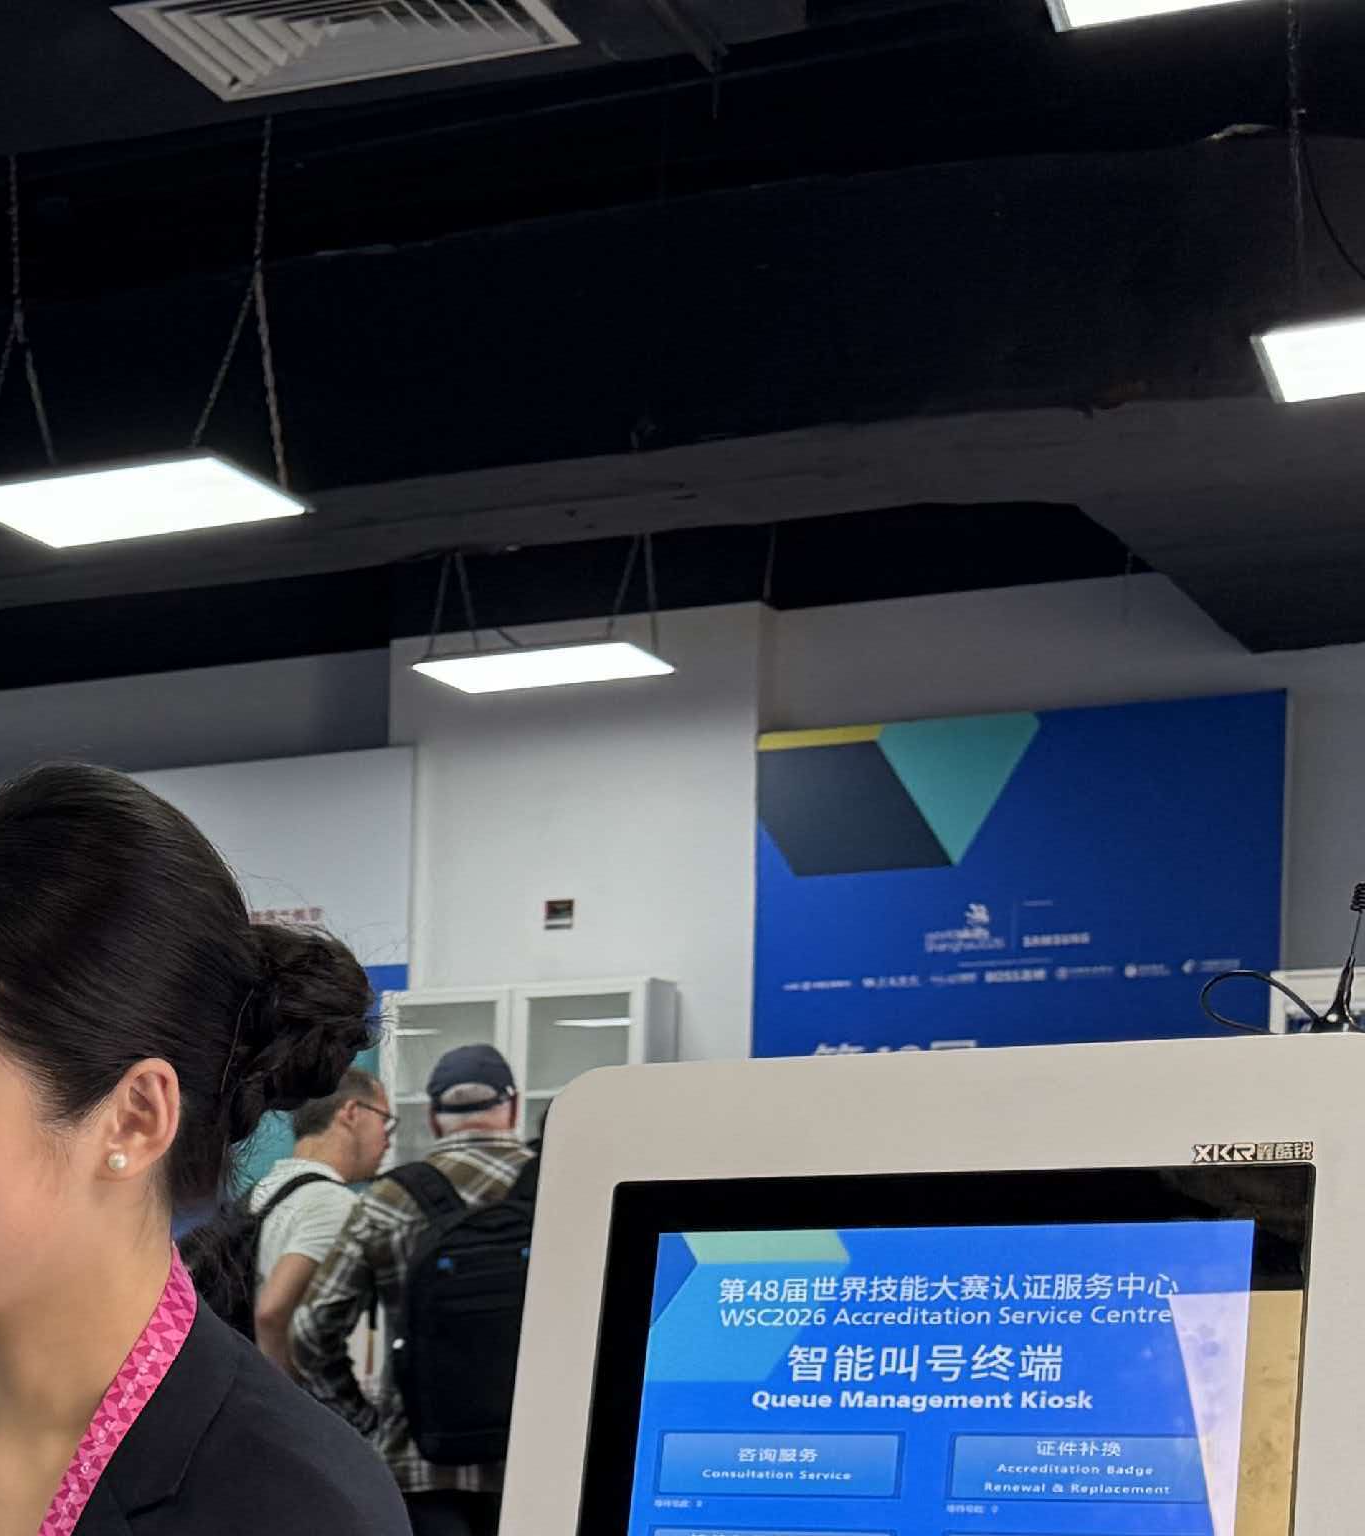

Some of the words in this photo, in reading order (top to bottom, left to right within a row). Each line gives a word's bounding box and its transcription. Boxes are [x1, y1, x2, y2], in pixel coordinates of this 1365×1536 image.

[719, 1271, 1179, 1305] 第48届世界技能大赛认证服务中心
[720, 1307, 826, 1328] WSC2026
[833, 1306, 991, 1327] Accreditation
[999, 1305, 1082, 1325] Service
[1091, 1305, 1172, 1324] Centre
[787, 1343, 1064, 1384] 智能叫号终端
[751, 1390, 832, 1410] Queue
[839, 1390, 1012, 1413] Management
[1020, 1390, 1093, 1410] Kiosk
[737, 1447, 818, 1463] 咨询服务
[1036, 1440, 1121, 1457] 证件补换
[701, 1468, 794, 1480] Consultation
[799, 1470, 852, 1481] Service
[996, 1463, 1100, 1475] Accreditation
[1106, 1464, 1153, 1477] Badge
[984, 1482, 1046, 1494] Renewal
[1051, 1483, 1063, 1494] &
[1070, 1483, 1171, 1496] Replacement
